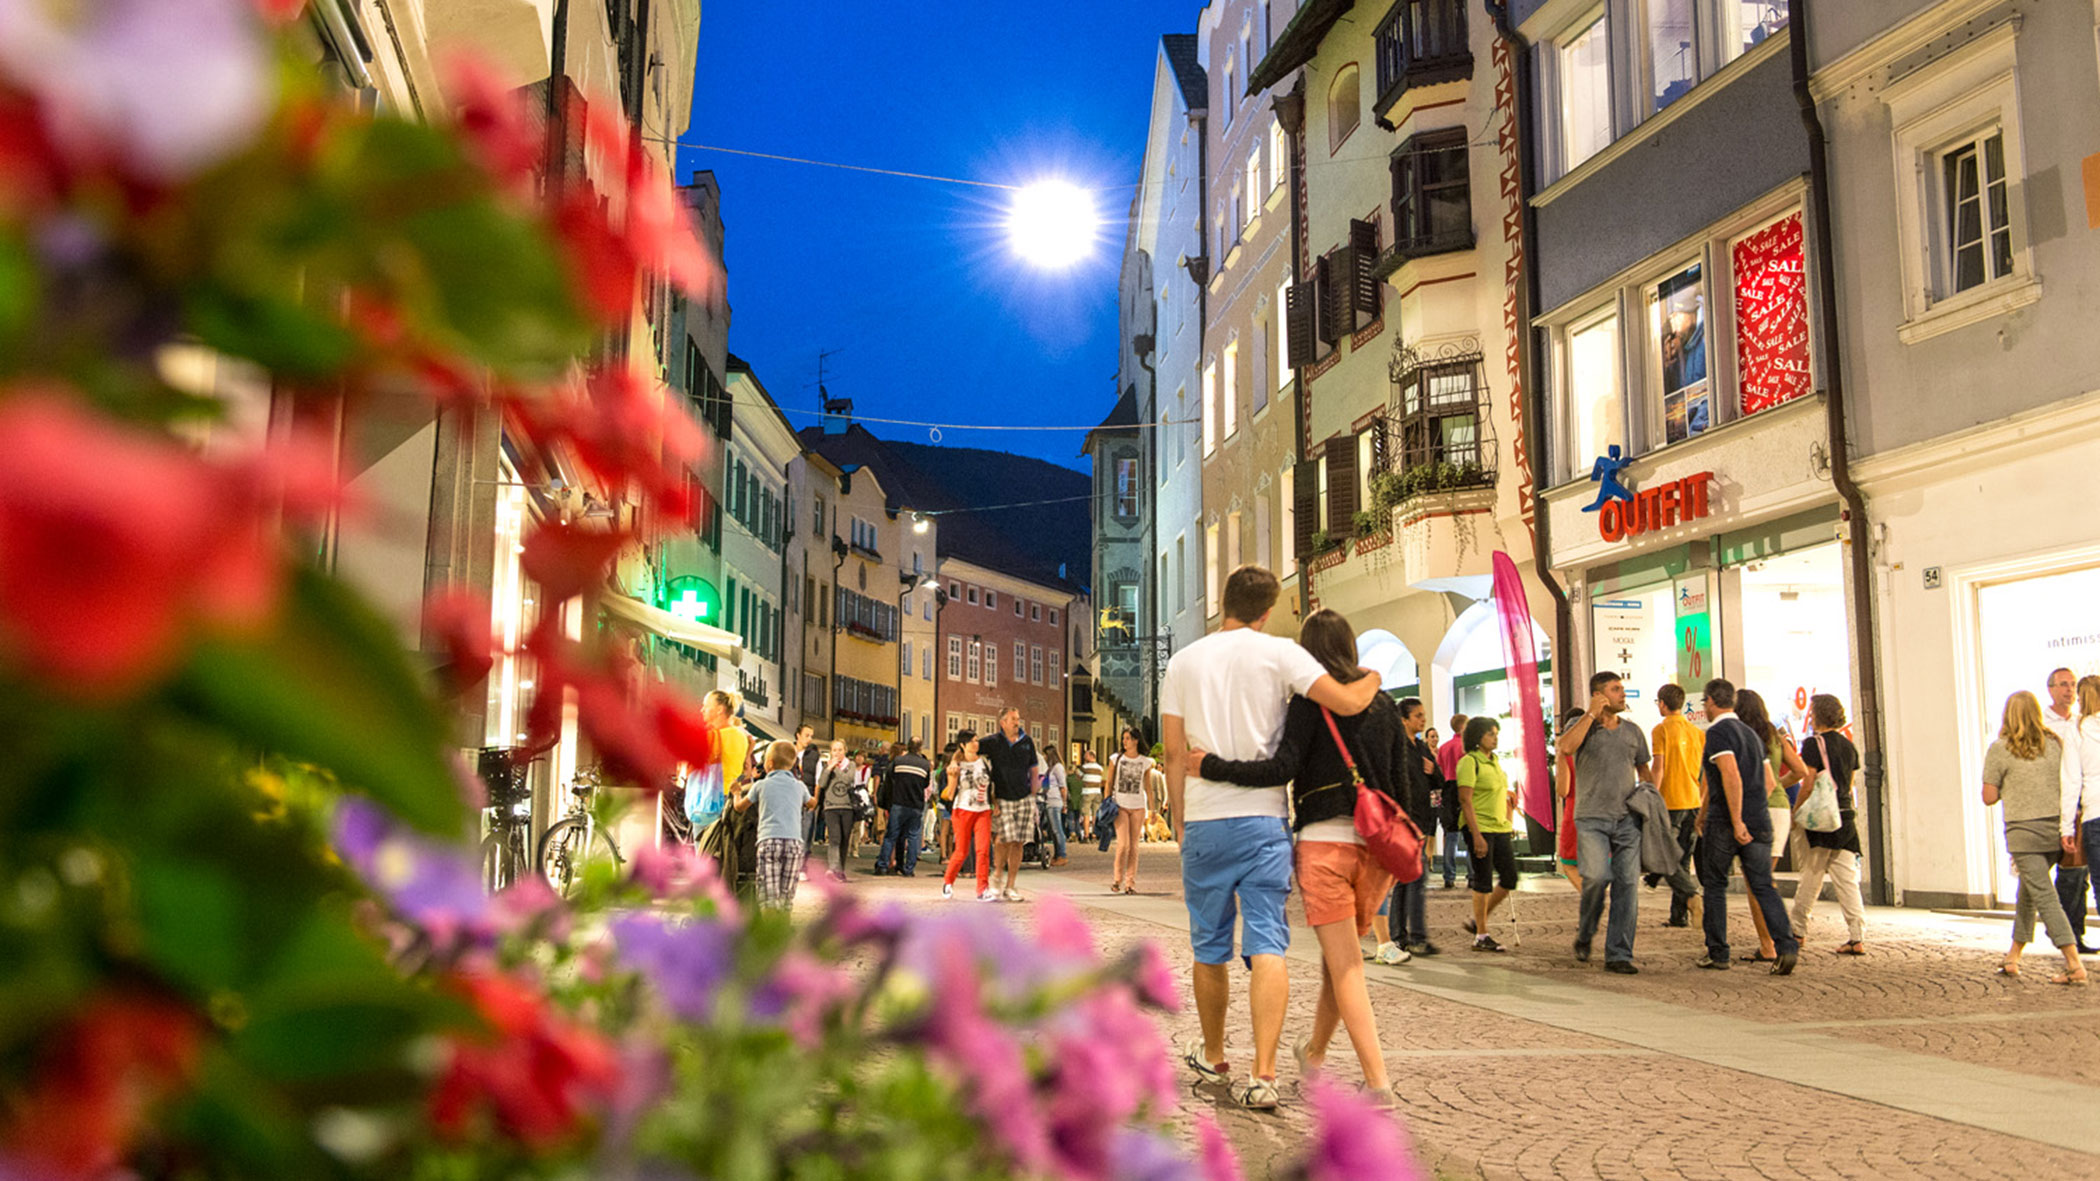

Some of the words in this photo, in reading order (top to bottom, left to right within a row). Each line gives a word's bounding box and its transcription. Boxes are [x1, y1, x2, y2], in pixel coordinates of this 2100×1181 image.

[1760, 235, 1778, 252] SALE
[1773, 231, 1800, 256] SALE
[1768, 260, 1805, 272] SAL
[1741, 287, 1764, 300] SALE
[1751, 293, 1785, 322] SALE
[1770, 297, 1793, 334] SALE
[1766, 333, 1784, 349] SALE
[1779, 331, 1806, 354] SALE
[1774, 357, 1810, 373] SAL
[1746, 383, 1769, 398] SALE
[1599, 471, 1714, 543] OUTFIT
[1925, 570, 1938, 582] 54
[1682, 593, 1705, 607] OUTFIT
